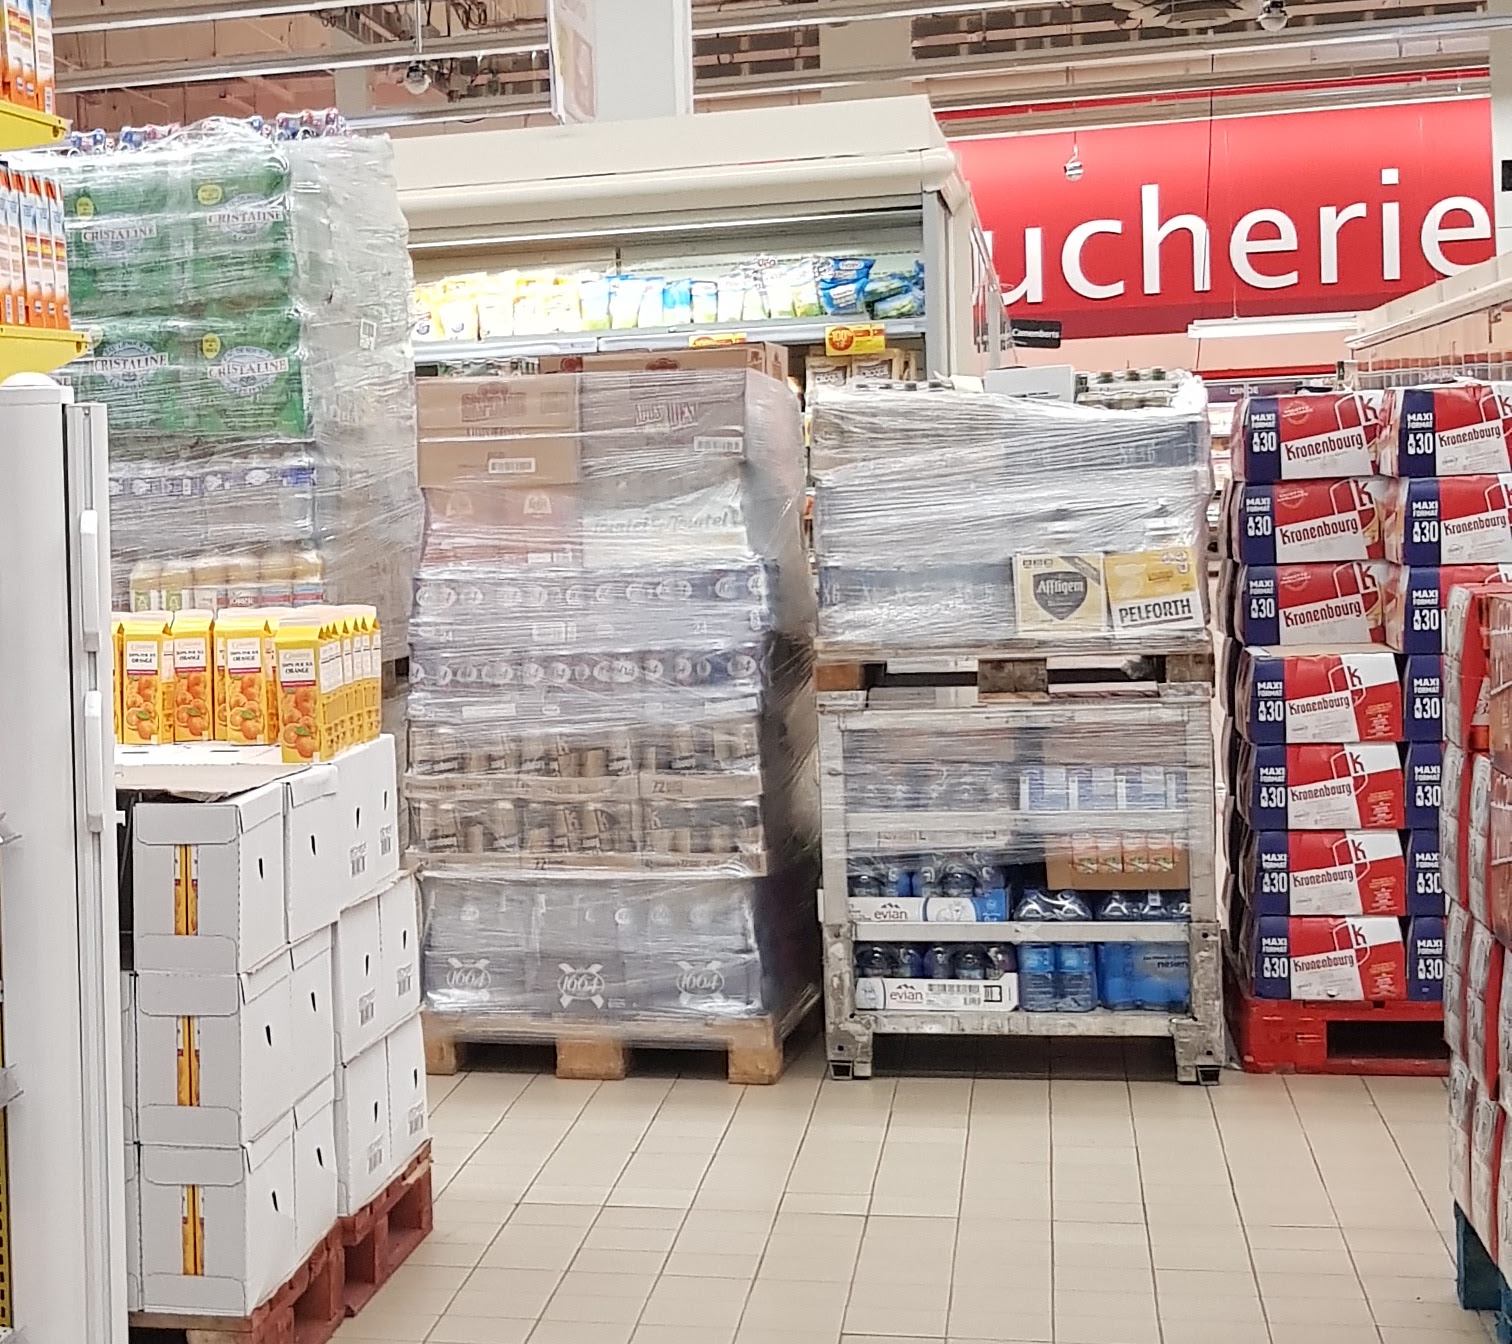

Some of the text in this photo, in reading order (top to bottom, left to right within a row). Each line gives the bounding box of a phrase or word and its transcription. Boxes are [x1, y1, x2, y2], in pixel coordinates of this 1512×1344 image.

[209, 211, 282, 223] CRISTALINE
[83, 227, 155, 241] CRISTALINE
[979, 167, 1493, 308] ucherie
[1012, 328, 1060, 340] Camemberts
[95, 355, 167, 371] CRISTALINE
[209, 361, 287, 377] CRISTALINE
[1251, 412, 1276, 421] MAXI
[1406, 412, 1433, 421] MAXI
[1260, 433, 1277, 452] 30
[1284, 430, 1364, 461] Kronenbourg
[1415, 433, 1433, 454] 30
[1439, 424, 1502, 449] Kronenbourg
[1246, 498, 1270, 506] MAXI
[1412, 500, 1438, 510] MAXI
[1255, 516, 1272, 536] 30
[1280, 519, 1360, 547] Kronenbourg
[1421, 521, 1438, 542] 30
[1444, 513, 1507, 537] Kronenbourg
[1037, 579, 1084, 595] Affligem
[1249, 579, 1274, 588] MAXI
[1412, 589, 1438, 598] MAXI
[1118, 598, 1192, 624] PELFORTH
[1258, 598, 1275, 618] 30
[1282, 599, 1362, 628] Kronenbourg
[1421, 609, 1439, 631] 30
[1257, 681, 1283, 690] MAXI
[1413, 678, 1439, 687] MAXI
[1266, 701, 1284, 721] 30
[1288, 694, 1351, 716] Kronenbourg
[1422, 698, 1440, 719] 30
[1260, 766, 1285, 775] MAXI
[1415, 765, 1440, 774] MAXI
[1268, 786, 1286, 808] 30
[1290, 780, 1353, 802] Kronenbourg
[1423, 785, 1441, 806] 30
[1262, 853, 1287, 862] MAXI
[1416, 852, 1440, 861] MAXI
[1270, 872, 1288, 893] 30
[1292, 867, 1355, 888] Kronenbourg
[1424, 872, 1441, 893] 30
[874, 907, 908, 921] evian
[1262, 937, 1287, 946] MAXI
[1417, 938, 1443, 947] MAXI
[1270, 957, 1288, 978] 30
[1293, 952, 1355, 974] Kronenbourg
[1426, 958, 1443, 979] 30
[449, 969, 487, 990] 1664
[561, 973, 601, 994] 1664
[679, 969, 721, 990] 1664
[889, 987, 923, 1003] evian
